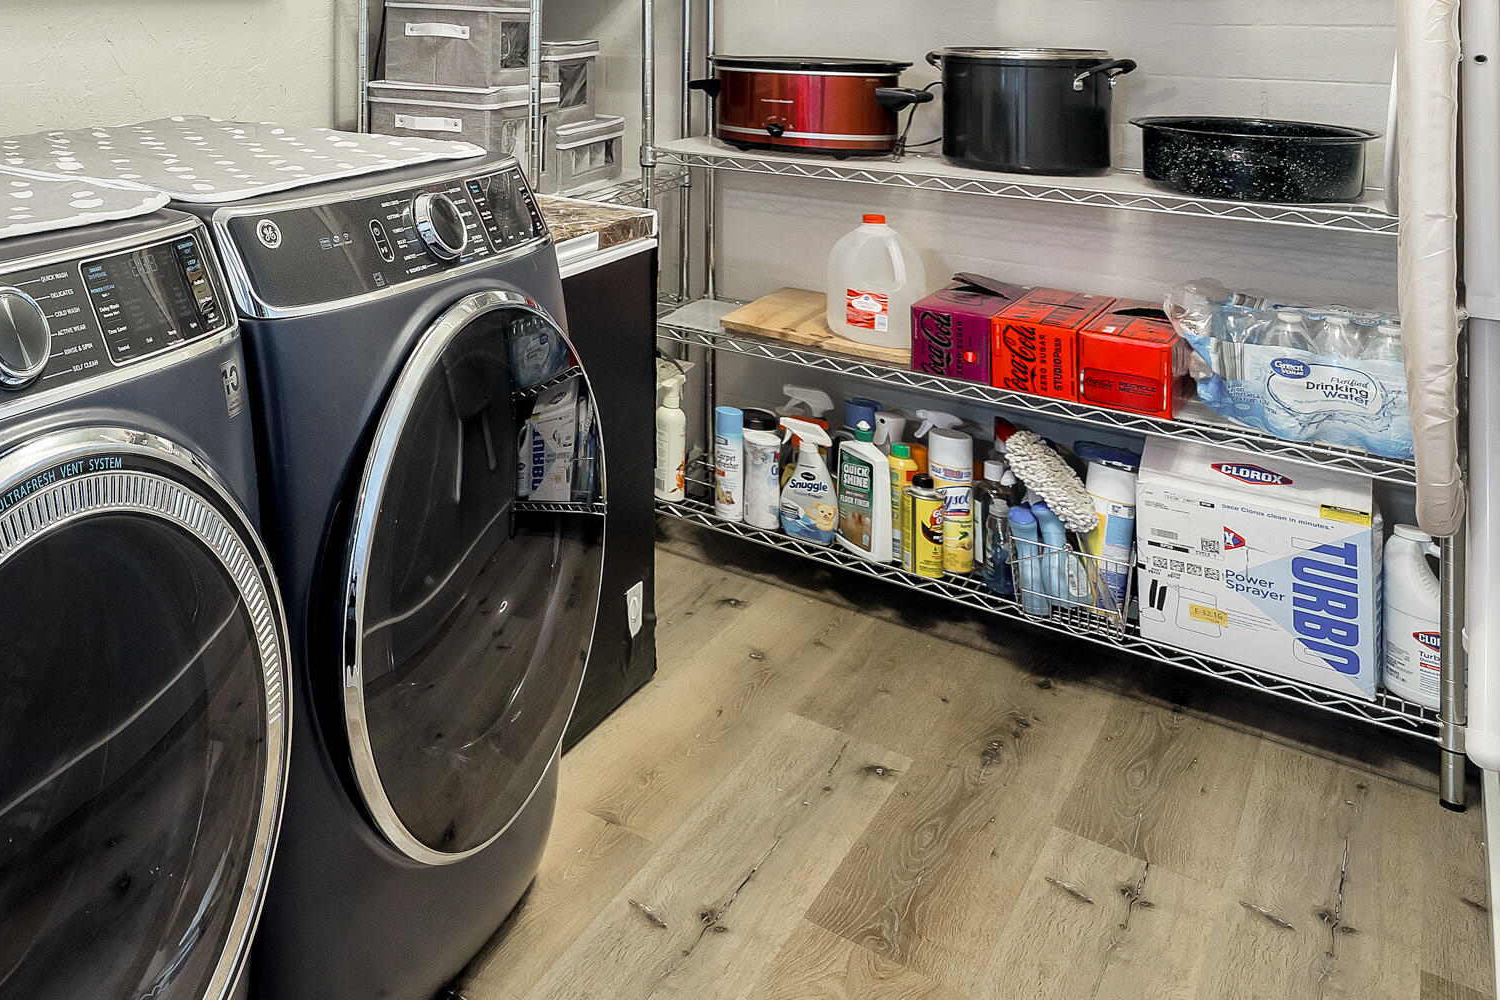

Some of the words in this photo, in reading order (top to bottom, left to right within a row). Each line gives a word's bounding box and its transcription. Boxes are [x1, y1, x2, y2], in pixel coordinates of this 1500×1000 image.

[40, 273, 55, 283] QUICK
[55, 271, 69, 280] WASH
[50, 288, 74, 299] DELICATES
[54, 308, 67, 317] COLD
[66, 306, 81, 315] WASH
[57, 326, 73, 336] ACTIVE
[72, 323, 87, 333] WEAR
[956, 321, 964, 349] SUGAR
[63, 347, 79, 355] RINSE
[82, 342, 94, 351] SPIN
[1039, 334, 1047, 364] SUGAR
[72, 363, 84, 372] SELF
[83, 360, 99, 369] CLEAN
[1274, 360, 1304, 371] Great
[1281, 367, 1304, 376] Value
[1040, 367, 1048, 391] ZERO
[1331, 376, 1369, 389] Purified
[1118, 381, 1157, 393] RECYCLE
[1306, 381, 1369, 399] Drinking
[1323, 390, 1370, 406] Water
[60, 461, 84, 478] VENT
[89, 457, 122, 471] SYSTEM
[843, 464, 869, 477] QUICK
[1221, 464, 1283, 485] CLOROX
[789, 478, 828, 492] Snuggle
[843, 473, 869, 488] SHINE
[840, 494, 854, 504] FLOOR
[854, 498, 870, 508] FINISH
[1241, 507, 1264, 517] Clorox
[1266, 513, 1287, 521] clean
[1225, 569, 1275, 589] Power
[1226, 580, 1285, 602] Sprayer
[1291, 537, 1360, 675] TURBO
